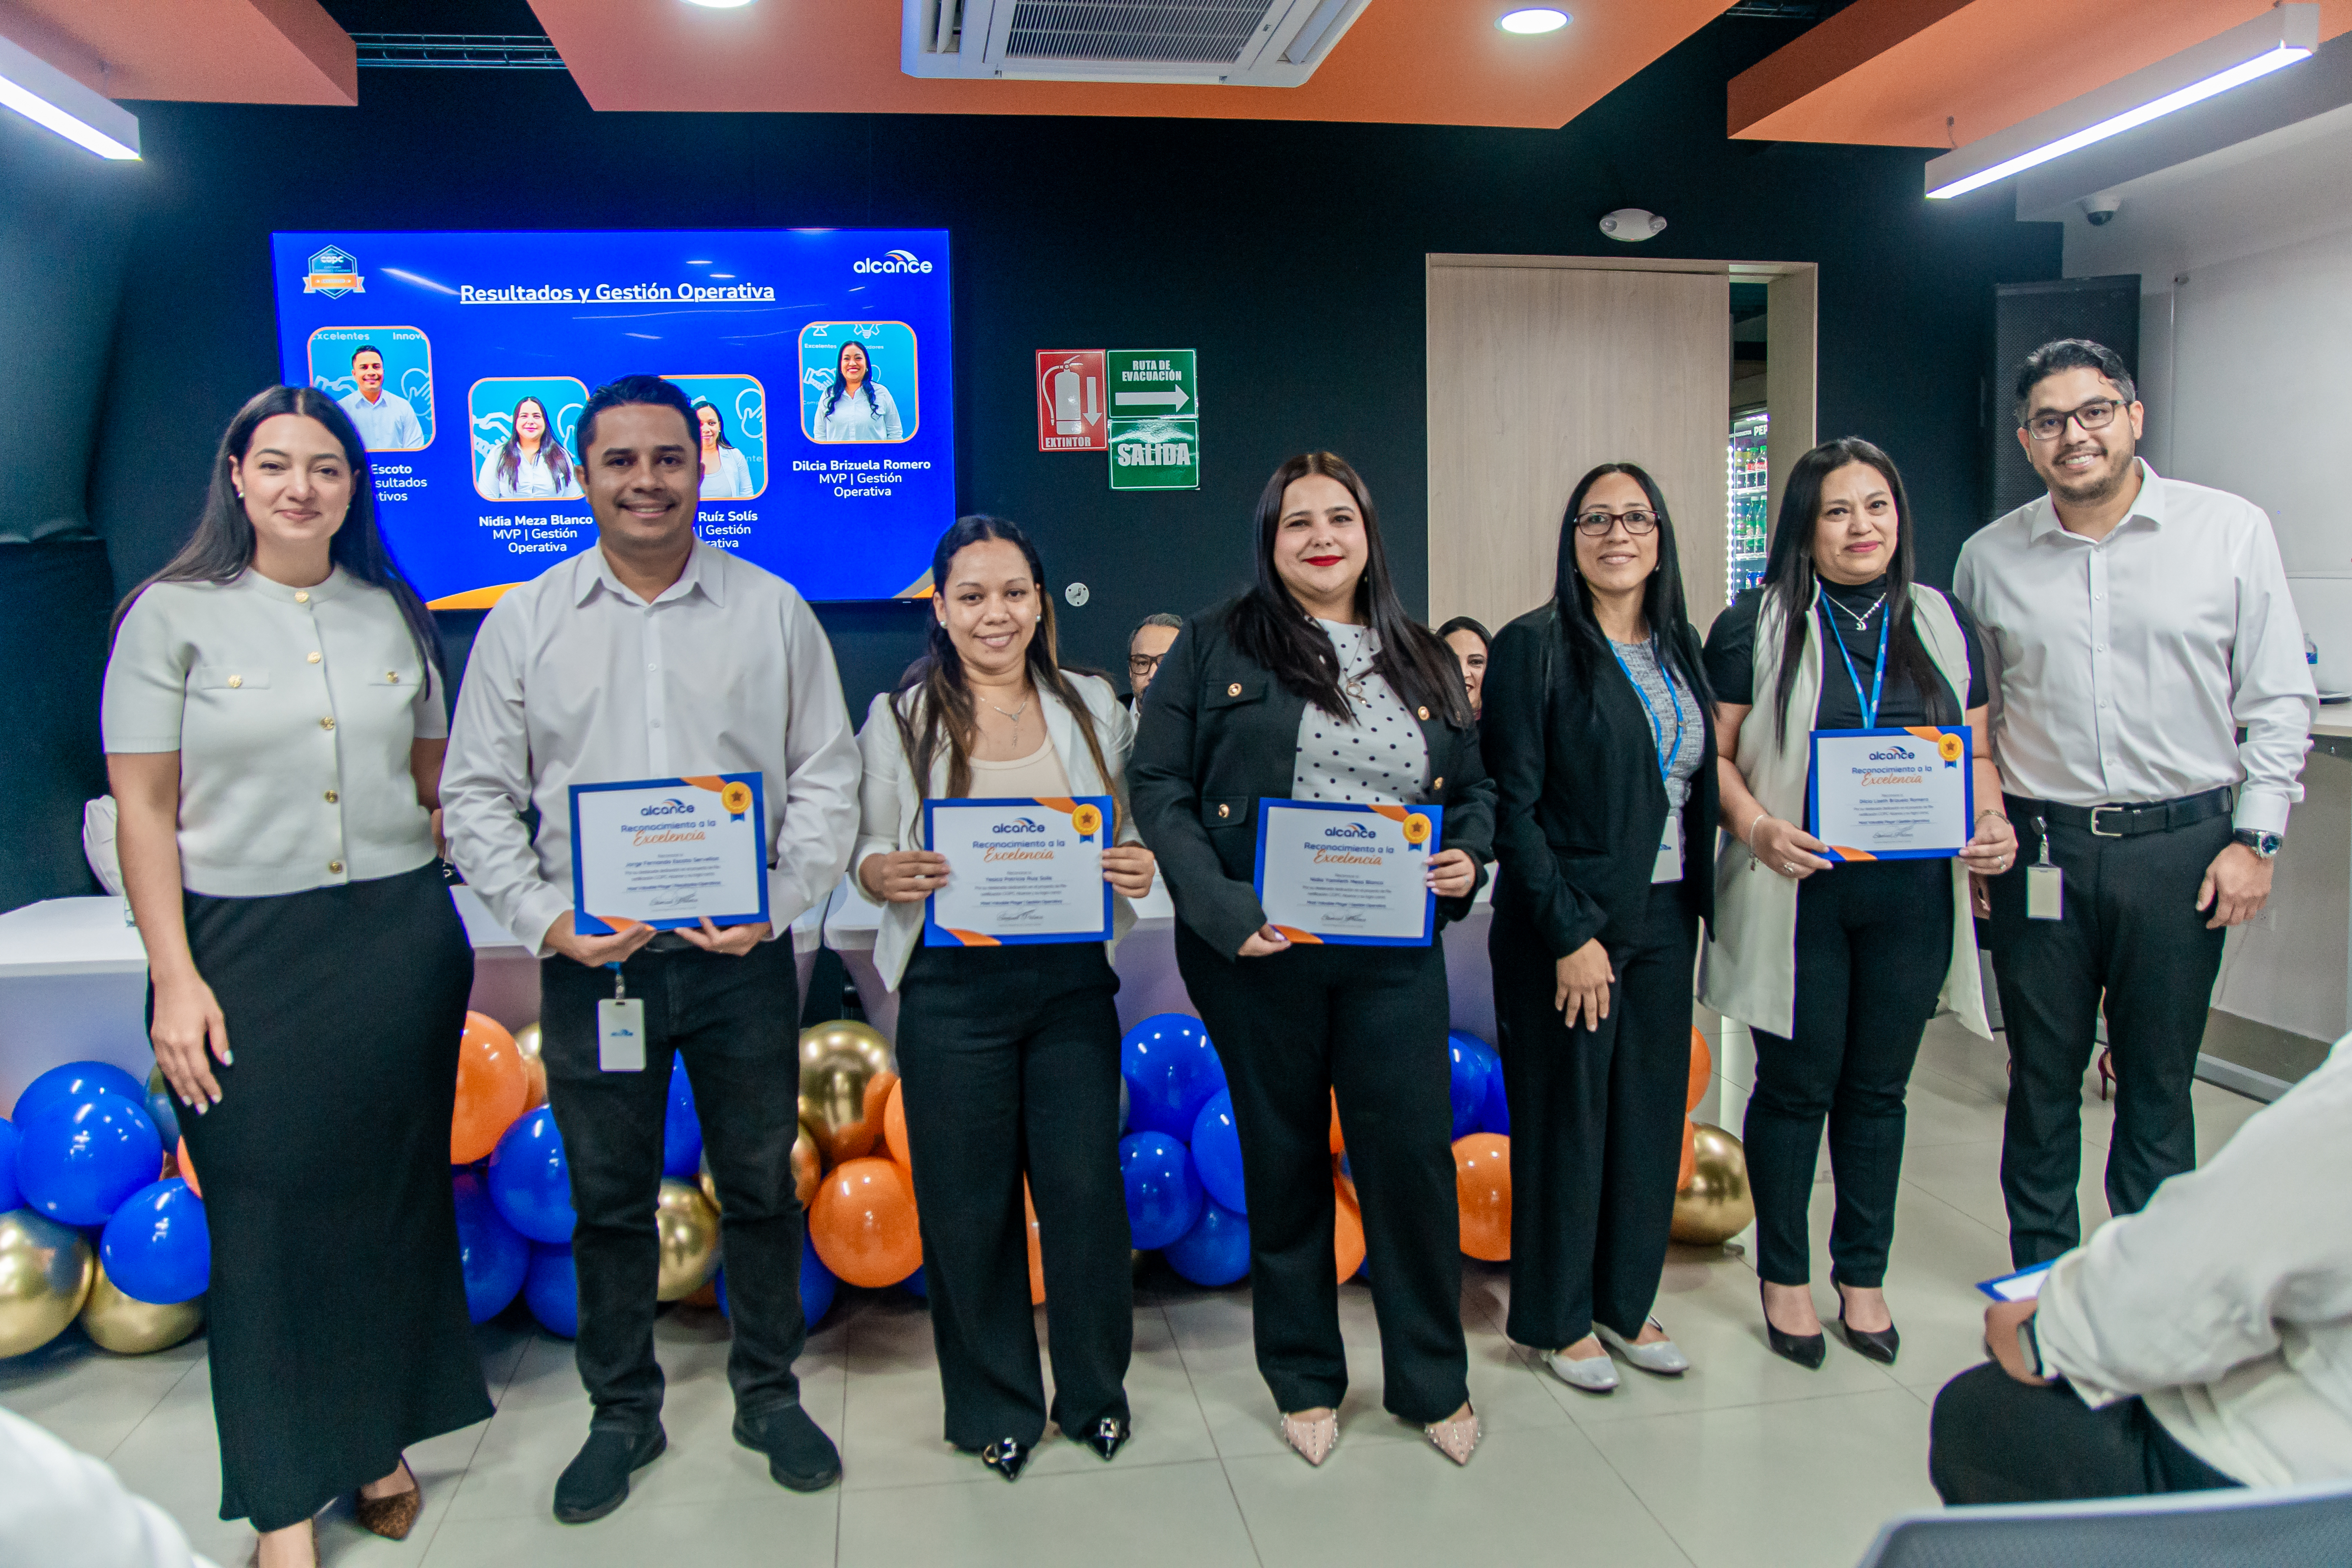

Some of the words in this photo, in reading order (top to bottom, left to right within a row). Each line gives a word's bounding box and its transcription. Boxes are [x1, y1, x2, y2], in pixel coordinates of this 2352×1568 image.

[854, 258, 932, 273] alcance
[461, 285, 573, 301] Resultados
[578, 288, 590, 303] y
[596, 282, 671, 299] Gestión
[678, 283, 774, 302] Operativa
[1133, 360, 1157, 370] RUTA
[1159, 360, 1170, 370] DE
[1122, 370, 1181, 382] EVACUACIÓN
[1045, 437, 1091, 448] EXTINTOR
[1118, 443, 1191, 466] SALIDA
[371, 464, 412, 474] Escoto
[792, 460, 827, 471] Dilcia
[831, 460, 880, 470] Brizuela
[883, 459, 931, 469] Romero
[375, 477, 427, 488] sultados
[819, 473, 847, 484] MVP
[858, 472, 902, 483] Gestión
[378, 491, 408, 501] tivos
[834, 486, 892, 499] Operativa
[479, 515, 512, 527] Nidia
[515, 515, 547, 526] Meza
[550, 514, 593, 525] Blanco
[698, 511, 724, 521] Ruíz
[728, 511, 758, 521] Solís
[493, 529, 521, 539] MVP
[532, 527, 577, 539] Gestión
[706, 524, 751, 535] Gestión
[508, 542, 567, 554] Operativa
[705, 538, 739, 548] rativa
[1869, 751, 1915, 760] alcance
[1861, 773, 1923, 786] Excelencia
[641, 804, 694, 816] alcance
[621, 821, 696, 833] Reconocimiento
[992, 823, 1045, 833] alcance
[1325, 827, 1376, 838] alcance
[633, 830, 706, 846] Excelencia
[973, 840, 1045, 849] Reconocimiento
[1304, 842, 1374, 853] Reconocimiento
[984, 847, 1054, 863] Excelencia
[1314, 849, 1383, 865] Excelencia
